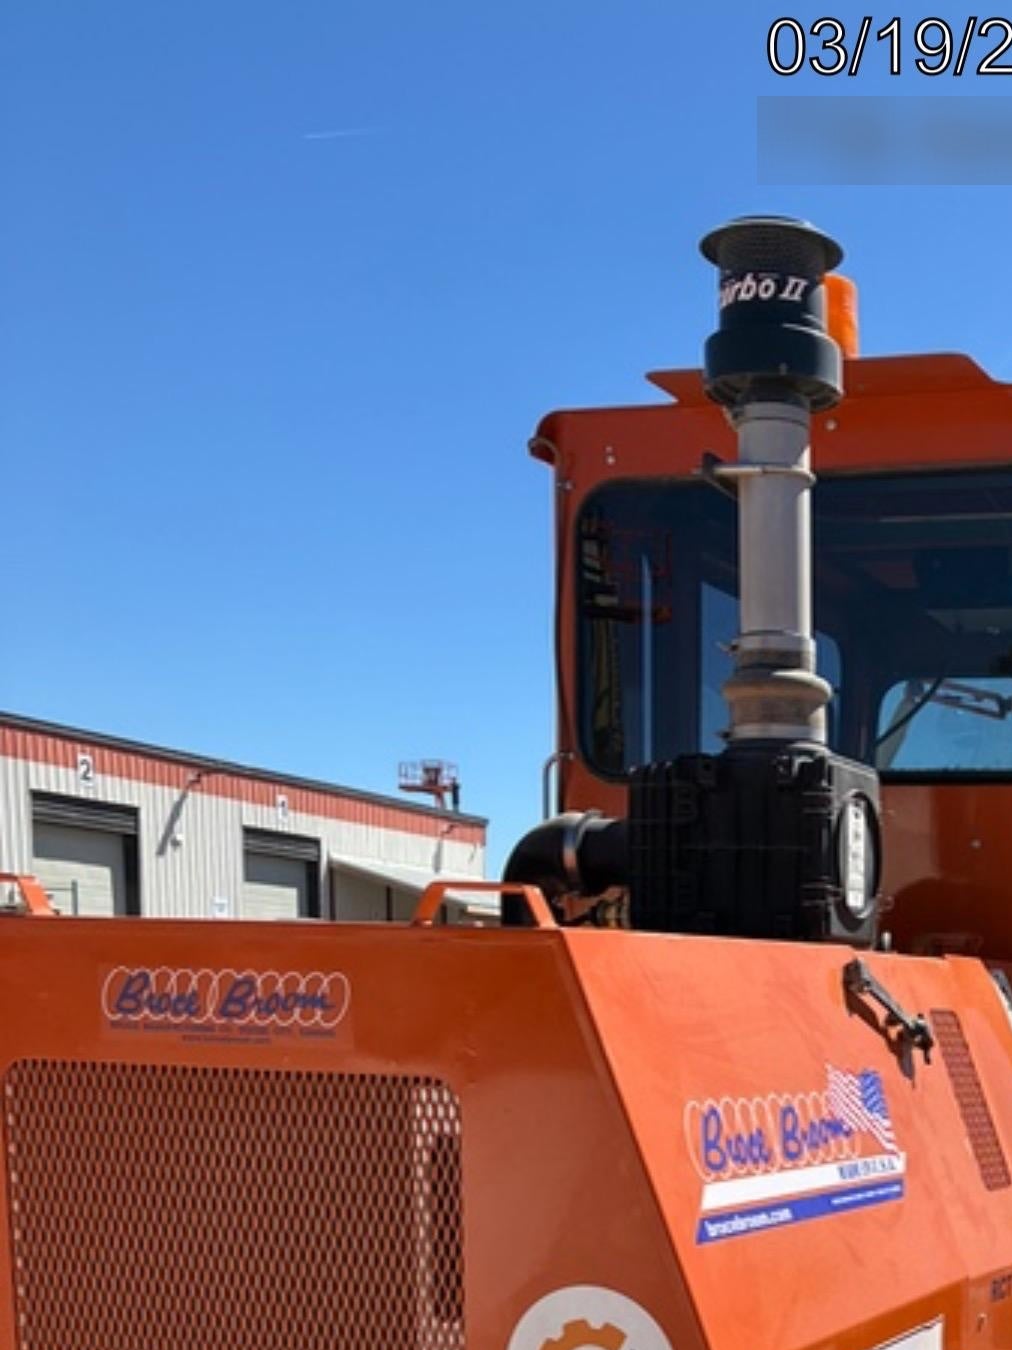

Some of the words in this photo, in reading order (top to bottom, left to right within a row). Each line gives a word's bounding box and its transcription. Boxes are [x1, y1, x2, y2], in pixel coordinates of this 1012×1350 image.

[78, 758, 92, 781] 2
[219, 976, 336, 1018] Broom
[780, 1103, 855, 1161] Broom
